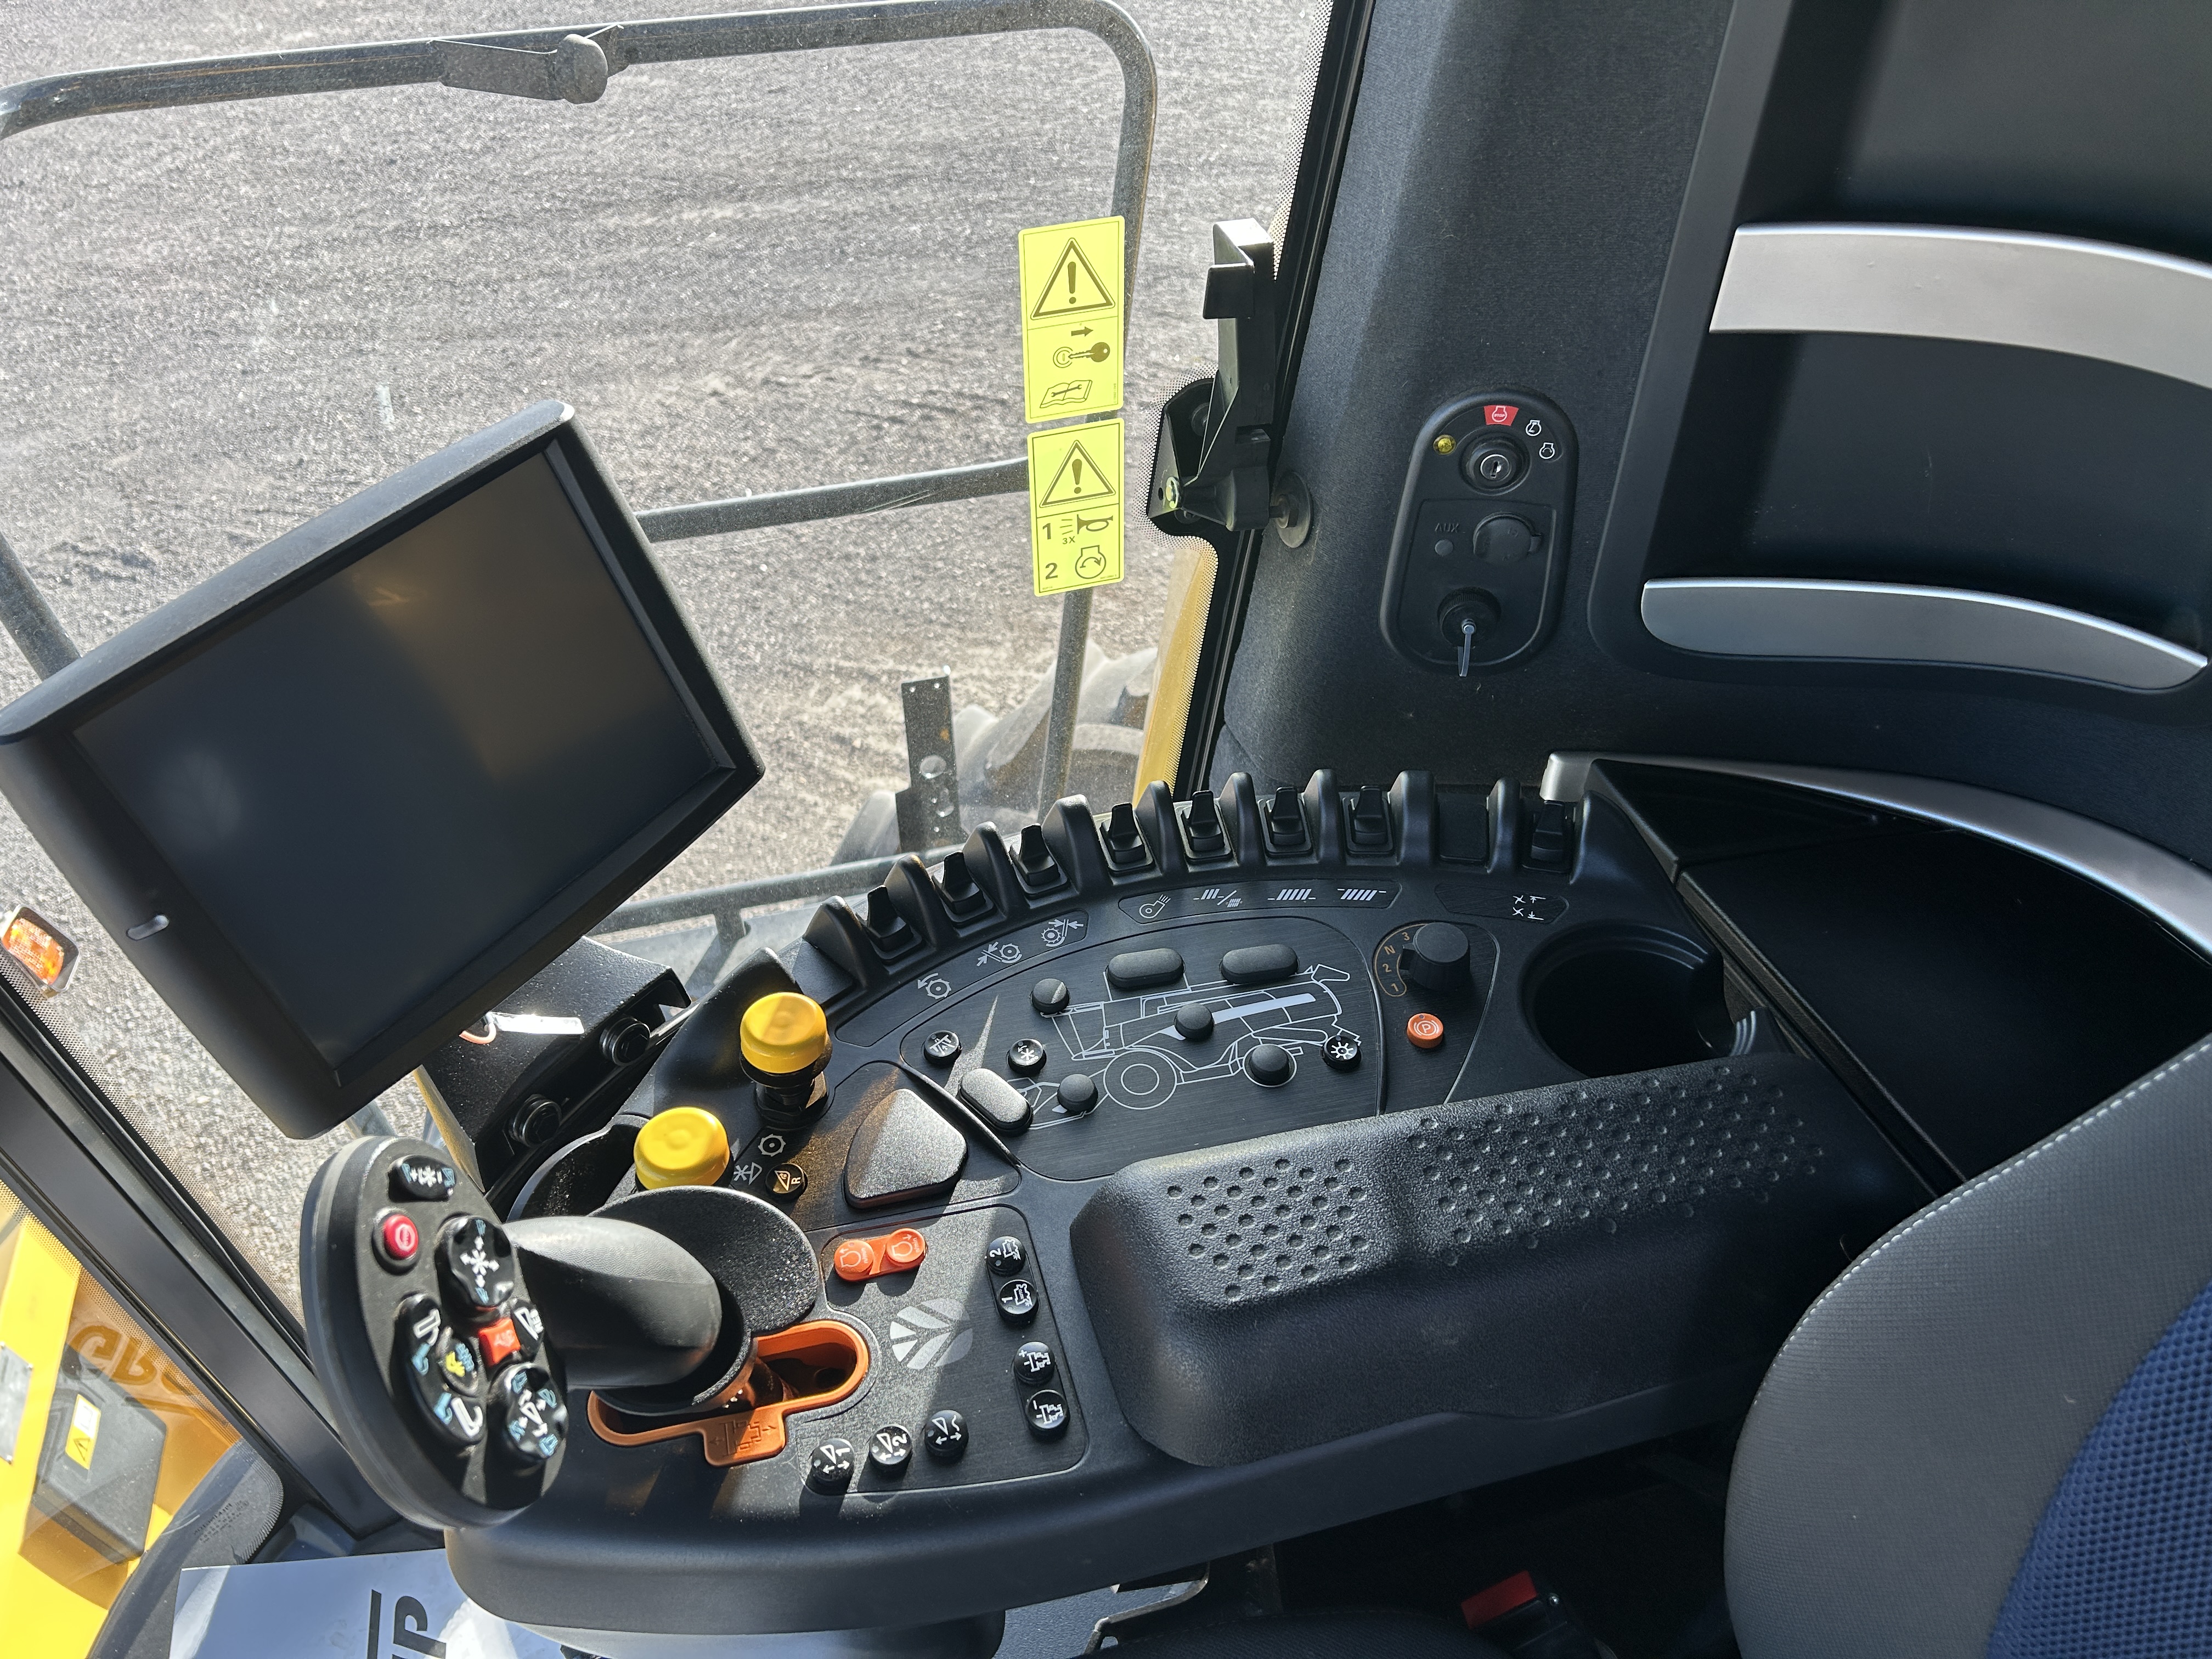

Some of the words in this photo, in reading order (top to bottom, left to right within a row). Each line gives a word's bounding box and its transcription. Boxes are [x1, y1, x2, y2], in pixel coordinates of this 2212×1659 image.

[1042, 523, 1051, 540] 1
[1435, 522, 1459, 533] AUX
[1062, 535, 1076, 545] 3X
[1045, 562, 1058, 580] 2
[1402, 932, 1410, 941] 3
[1384, 945, 1396, 955] N
[1382, 963, 1392, 973] 2
[1391, 983, 1399, 992] 1
[1421, 1023, 1431, 1034] P
[989, 1248, 1002, 1257] 2
[892, 1433, 907, 1447] 2
[835, 1447, 850, 1457] 1
